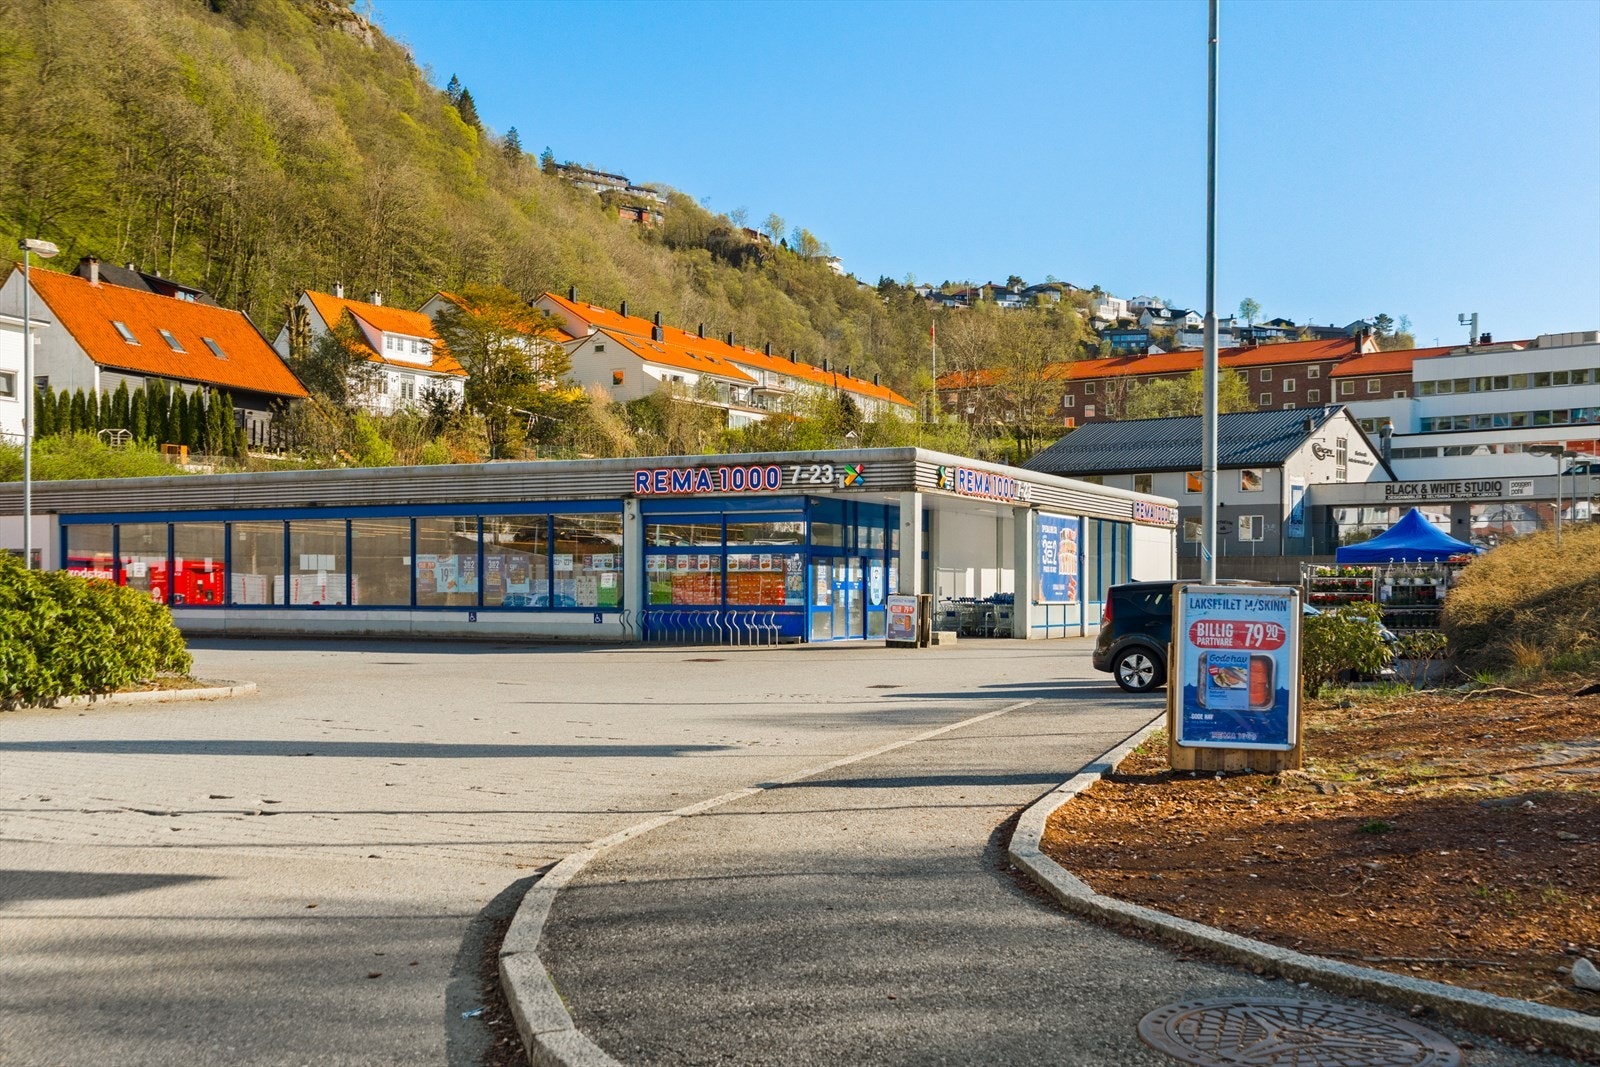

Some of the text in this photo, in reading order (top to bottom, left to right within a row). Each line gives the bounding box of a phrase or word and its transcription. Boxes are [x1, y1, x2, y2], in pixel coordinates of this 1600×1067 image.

[634, 465, 782, 494] REMA 1000
[957, 468, 1016, 502] REMA 1000
[1385, 481, 1502, 495] BLACK & WHITE STUDIO
[1196, 636, 1233, 647] PARTIVARE
[1197, 622, 1278, 648] BILLIG 79 90
